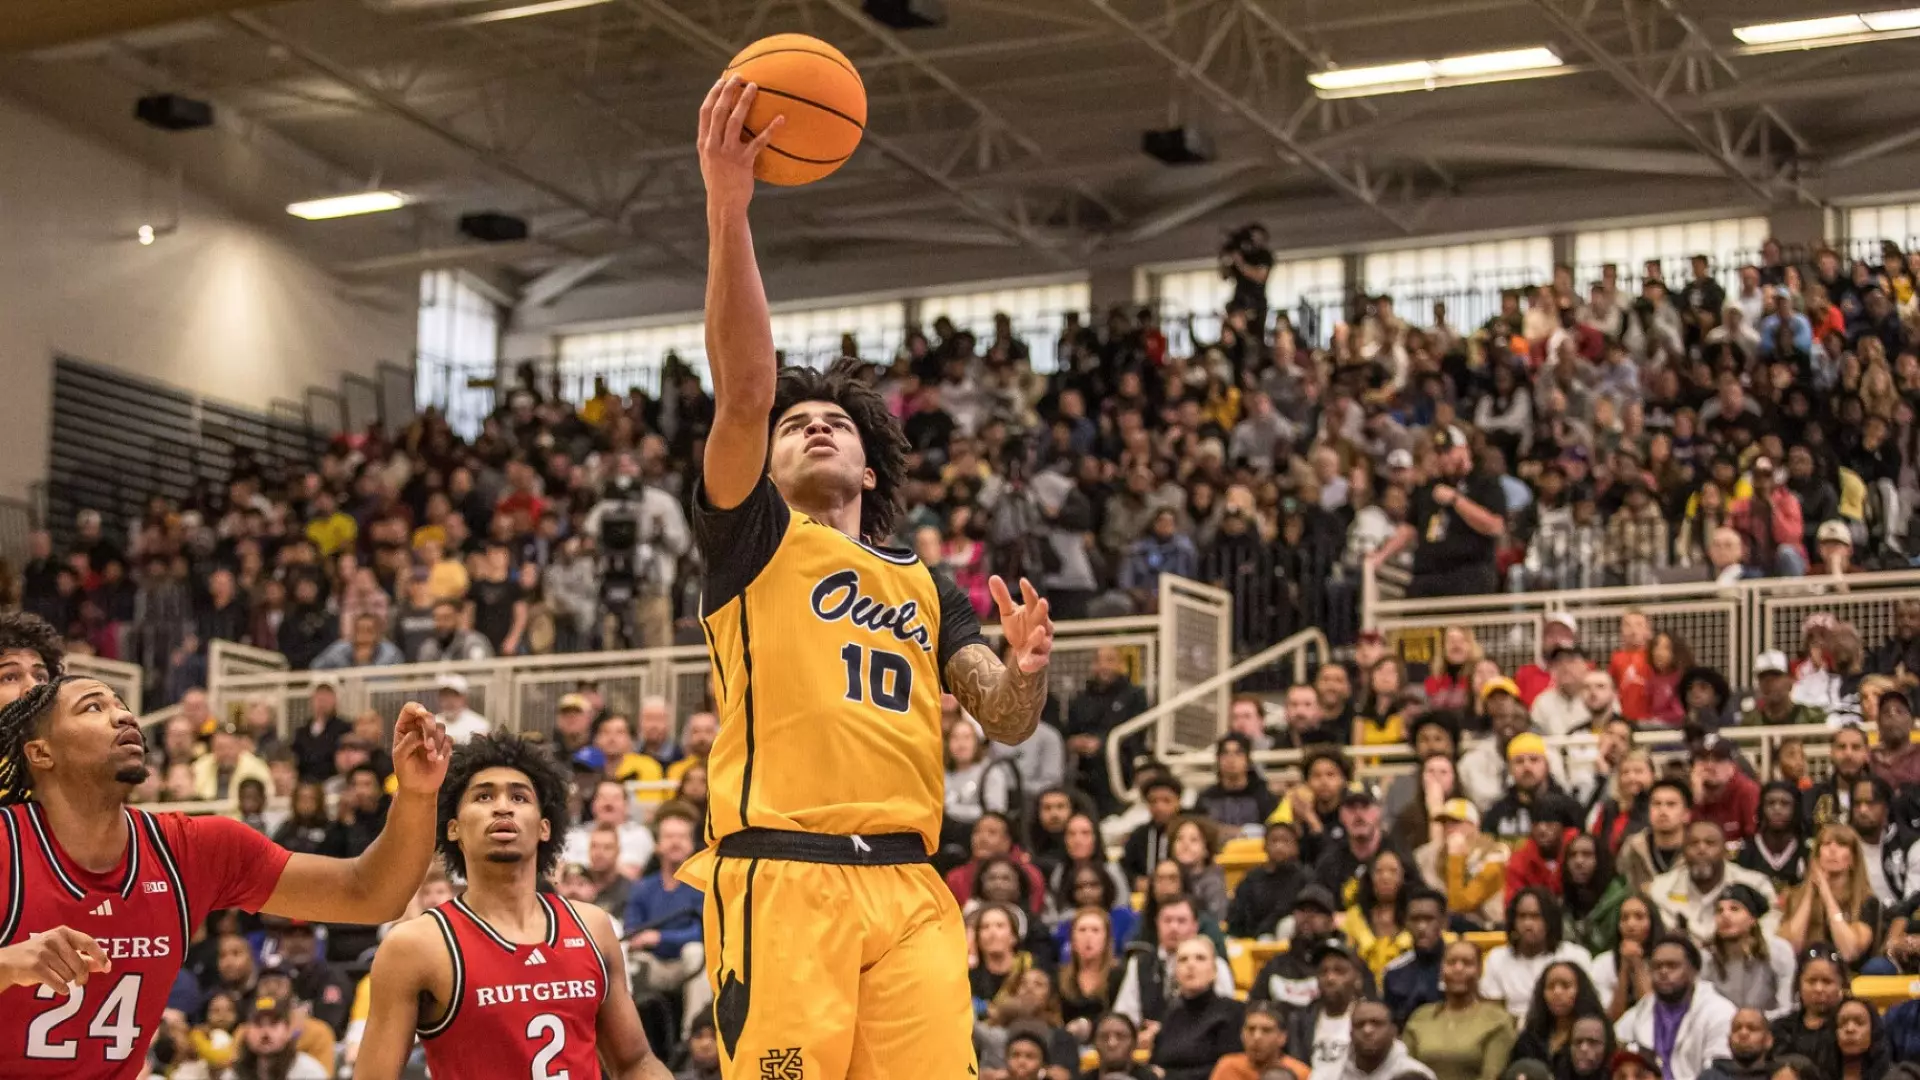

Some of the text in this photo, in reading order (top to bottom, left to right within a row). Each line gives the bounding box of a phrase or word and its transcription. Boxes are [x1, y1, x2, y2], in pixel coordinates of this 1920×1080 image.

[811, 568, 932, 652] Owls
[841, 641, 914, 713] 10
[26, 972, 144, 1060] 24
[476, 980, 597, 1007] RUTGERS
[526, 1012, 570, 1080] 2
